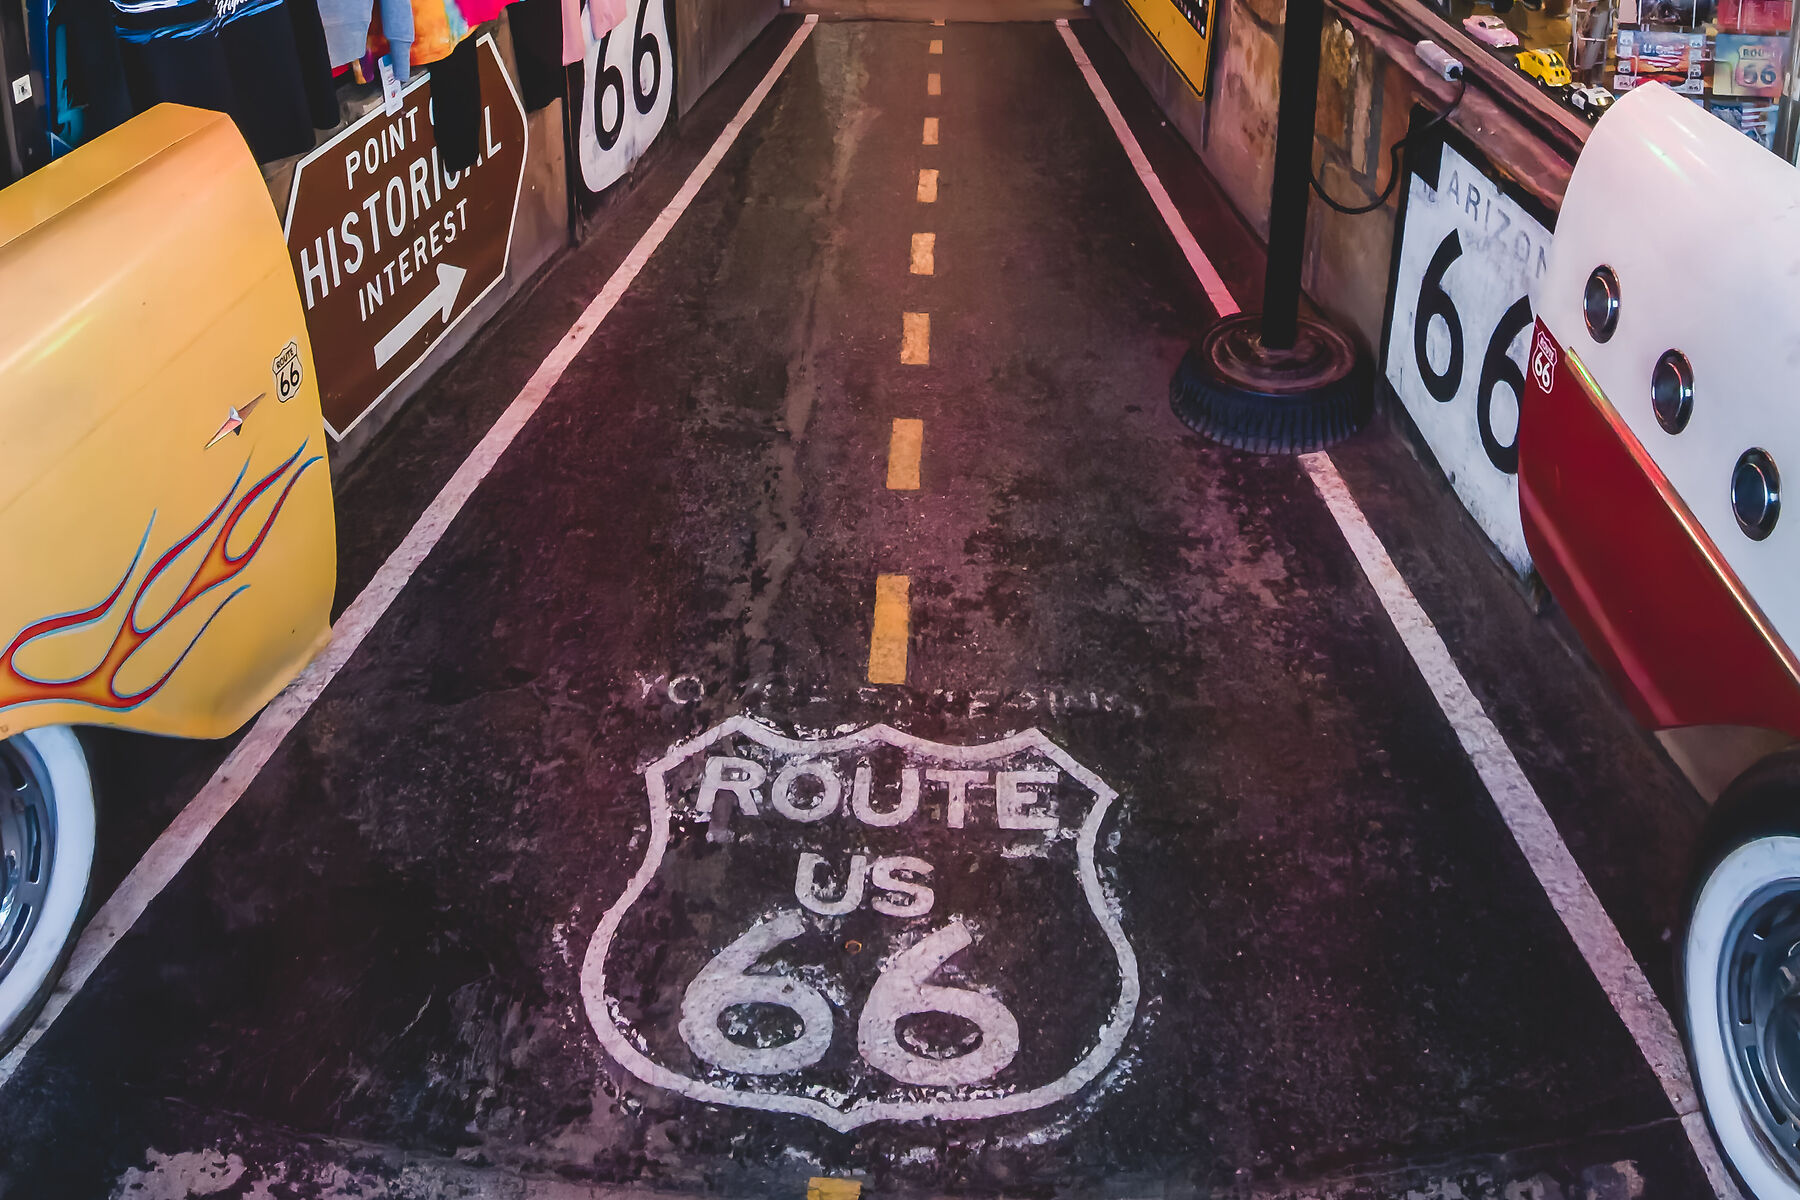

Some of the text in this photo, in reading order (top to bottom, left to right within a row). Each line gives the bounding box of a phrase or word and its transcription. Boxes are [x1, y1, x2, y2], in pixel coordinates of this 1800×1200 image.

[1743, 63, 1777, 85] 66
[344, 106, 419, 191] POINT
[300, 105, 503, 311] HISTORIL
[358, 198, 469, 322] INTEREST
[276, 347, 294, 369] ROUTE
[280, 361, 300, 397] 66
[1414, 228, 1535, 476] 66
[1535, 351, 1551, 388] 66
[695, 755, 1060, 830] ROUTE
[794, 851, 936, 918] US
[678, 908, 1021, 1088] 66
